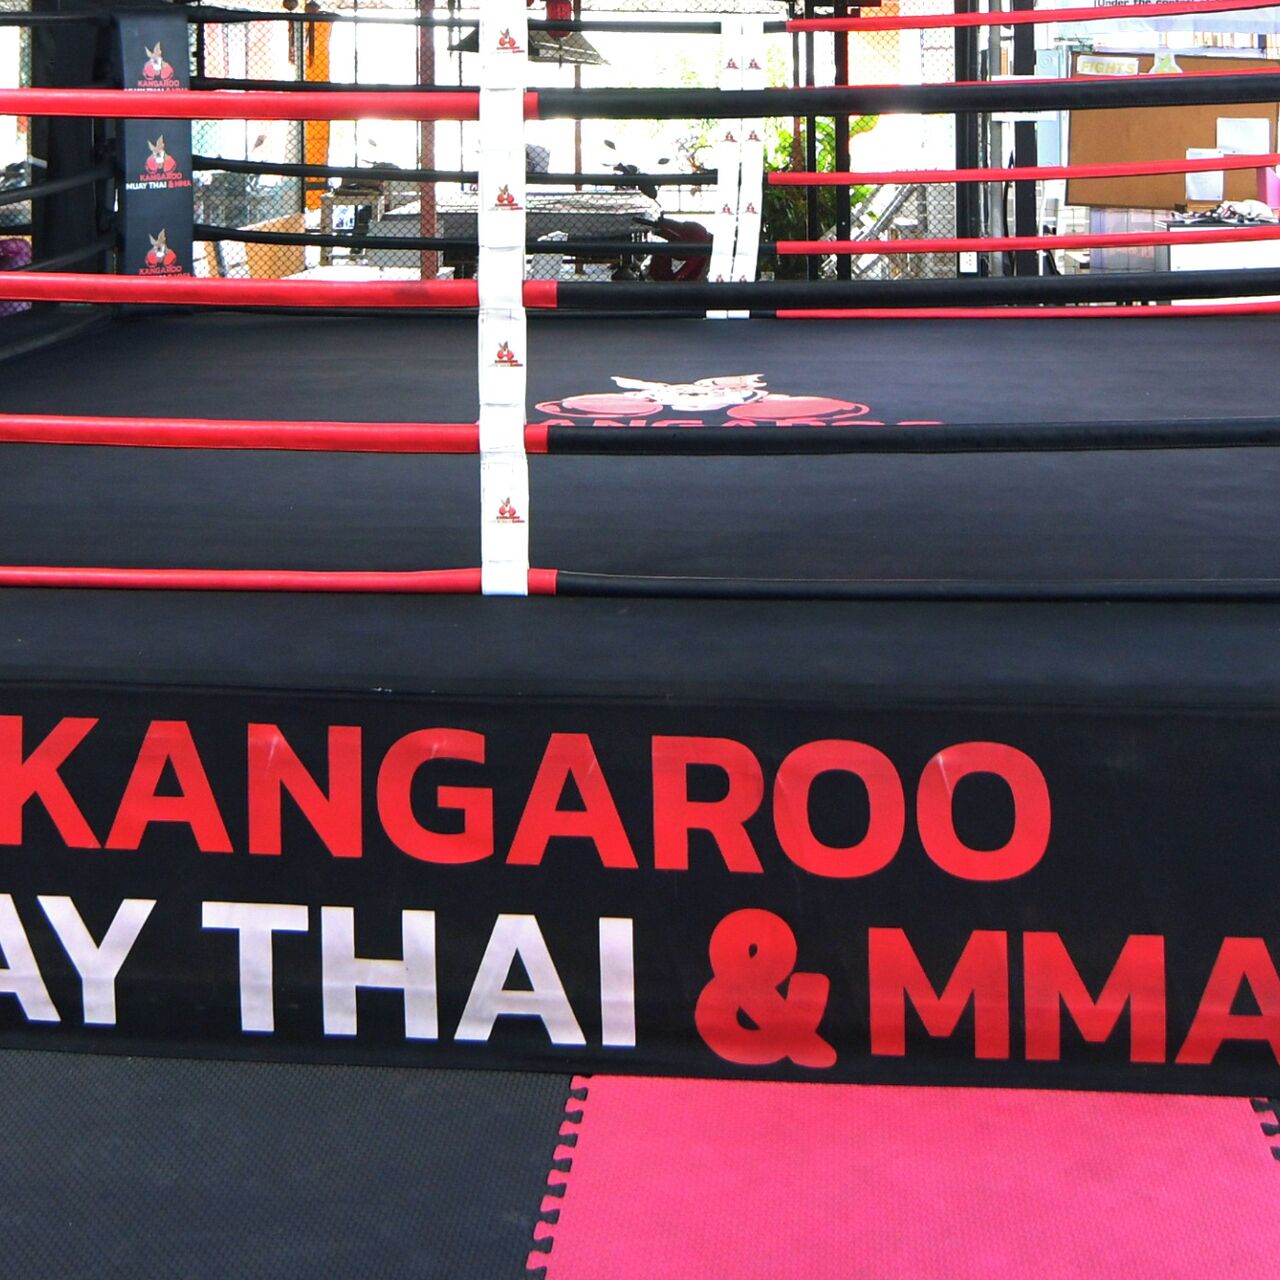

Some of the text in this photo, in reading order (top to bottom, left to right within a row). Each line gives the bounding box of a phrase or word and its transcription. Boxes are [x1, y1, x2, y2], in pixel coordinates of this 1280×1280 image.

[125, 182, 148, 190] MUAY
[149, 181, 167, 189] THAI
[201, 901, 637, 1048] THAI
[695, 908, 837, 1069] &
